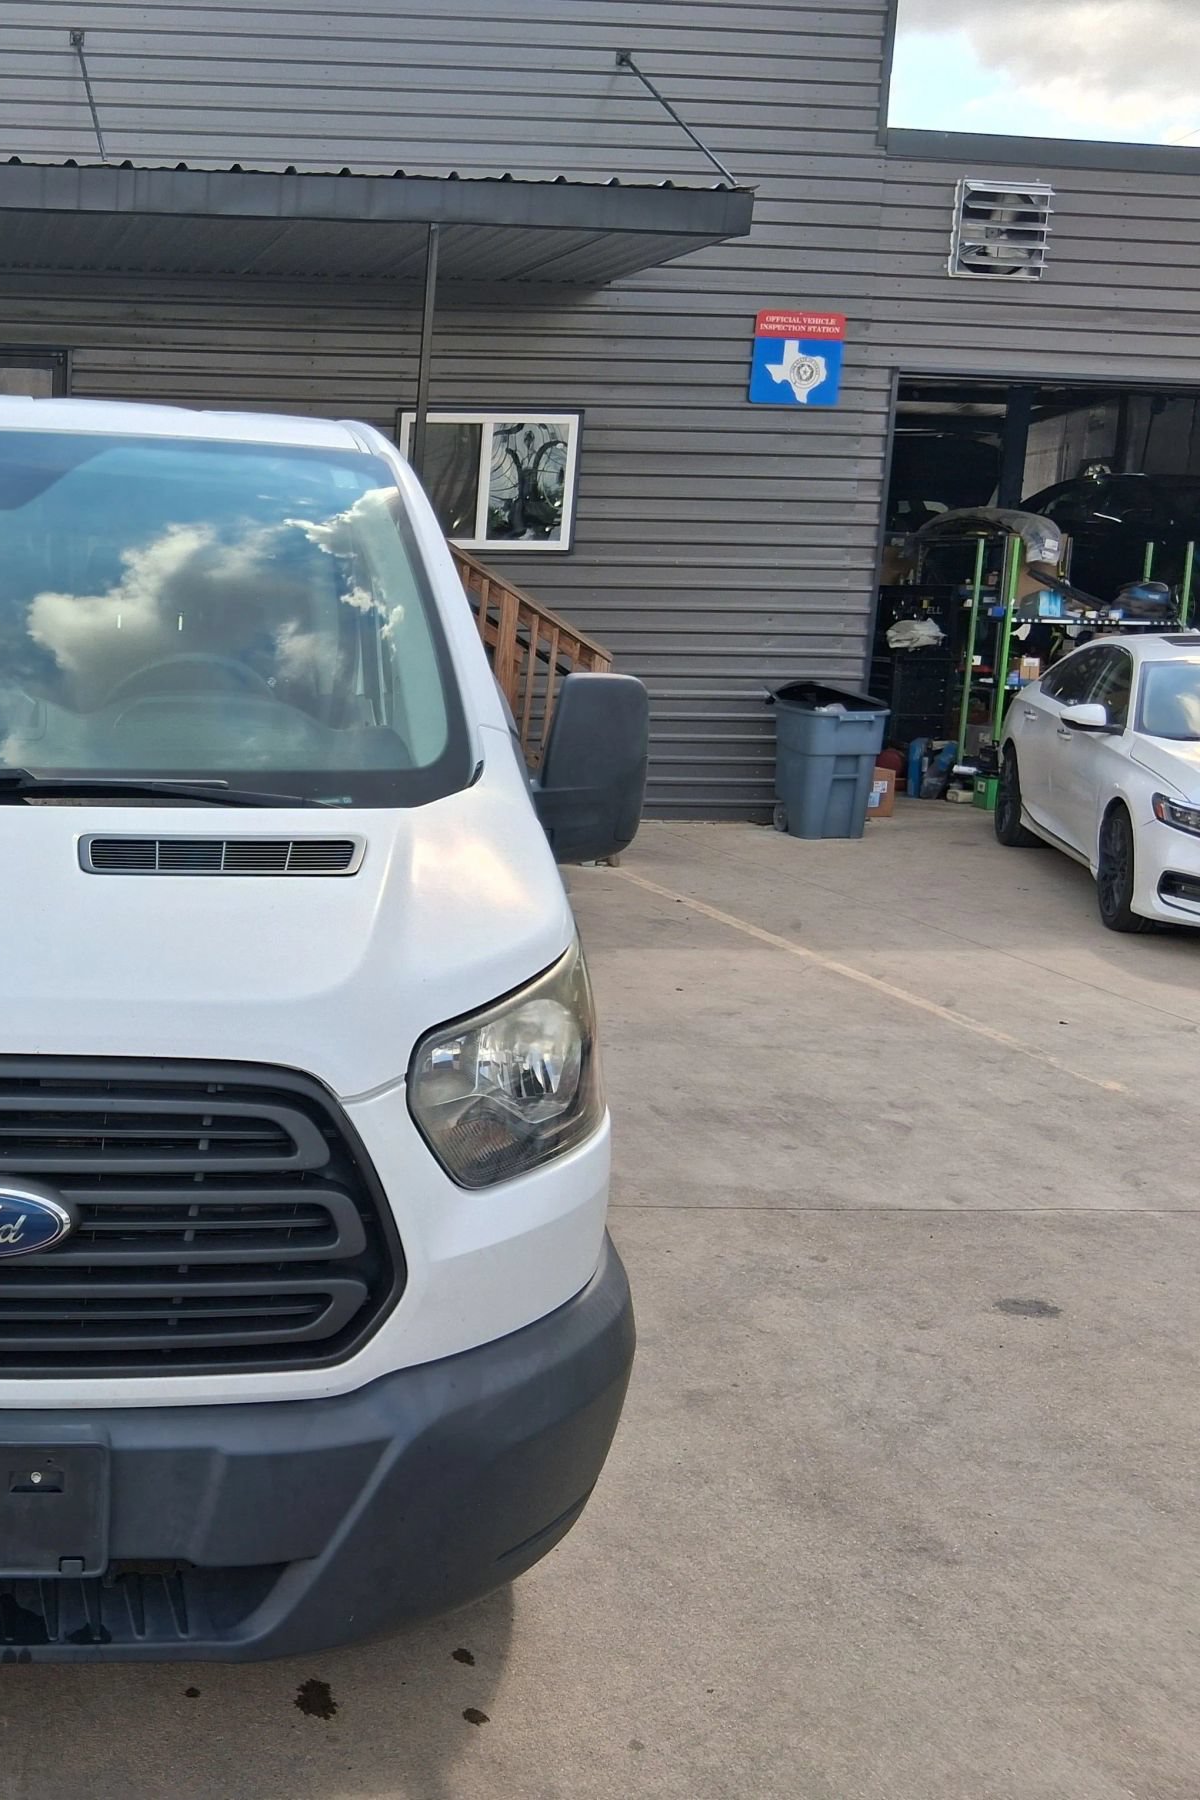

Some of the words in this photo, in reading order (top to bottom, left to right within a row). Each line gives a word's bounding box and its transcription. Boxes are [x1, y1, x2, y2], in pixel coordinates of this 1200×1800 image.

[765, 315, 801, 323] OFFICIAL
[802, 317, 836, 325] VEHICLE
[760, 323, 806, 332] INSPECTION
[807, 326, 840, 334] STATION
